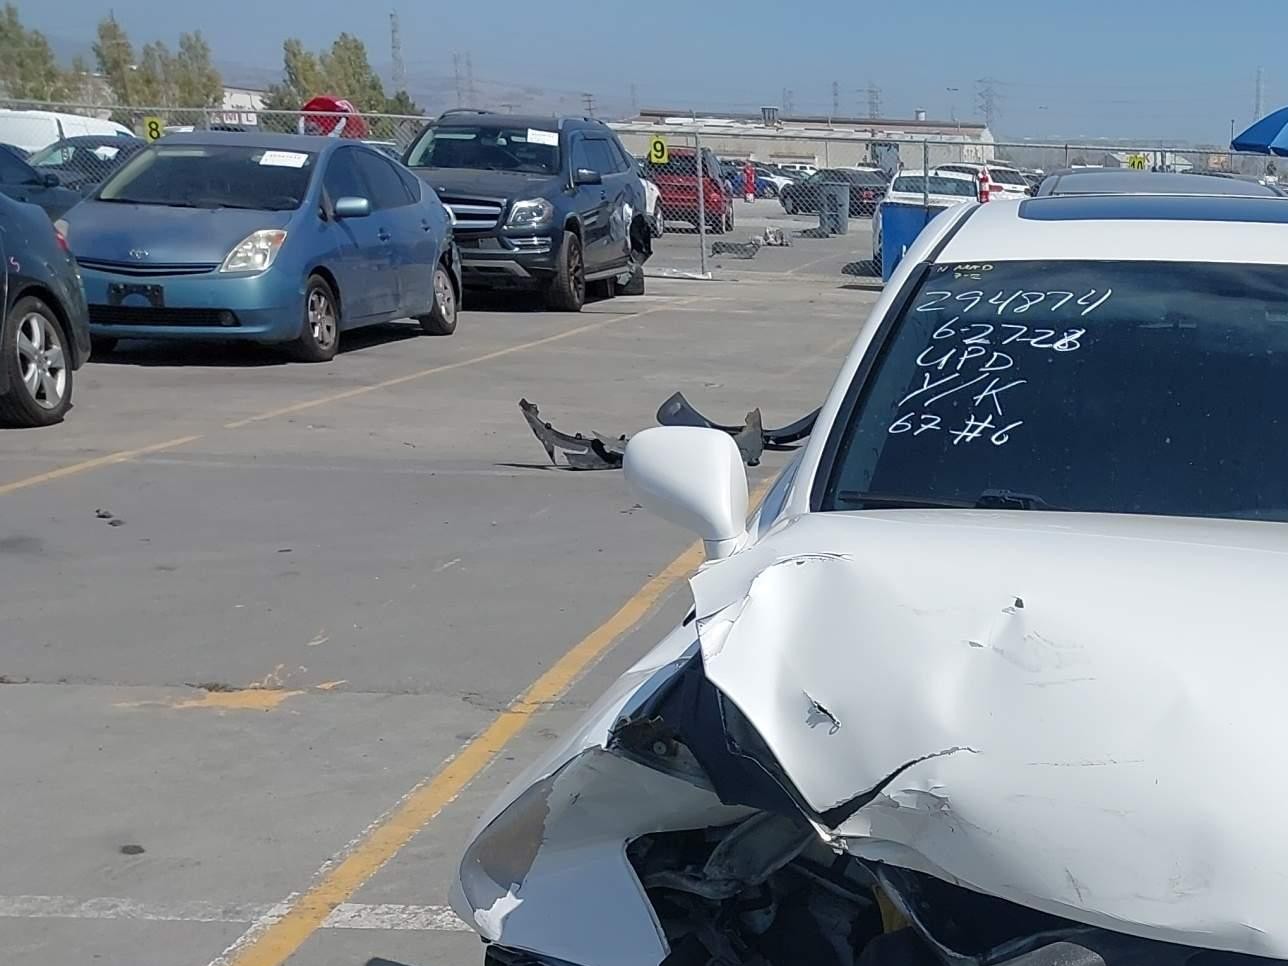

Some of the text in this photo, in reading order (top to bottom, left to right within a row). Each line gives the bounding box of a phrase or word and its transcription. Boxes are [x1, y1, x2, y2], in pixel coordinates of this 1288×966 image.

[149, 121, 160, 139] 8
[653, 140, 665, 159] 9
[916, 288, 1112, 316] 294874
[949, 413, 1023, 445] #6
